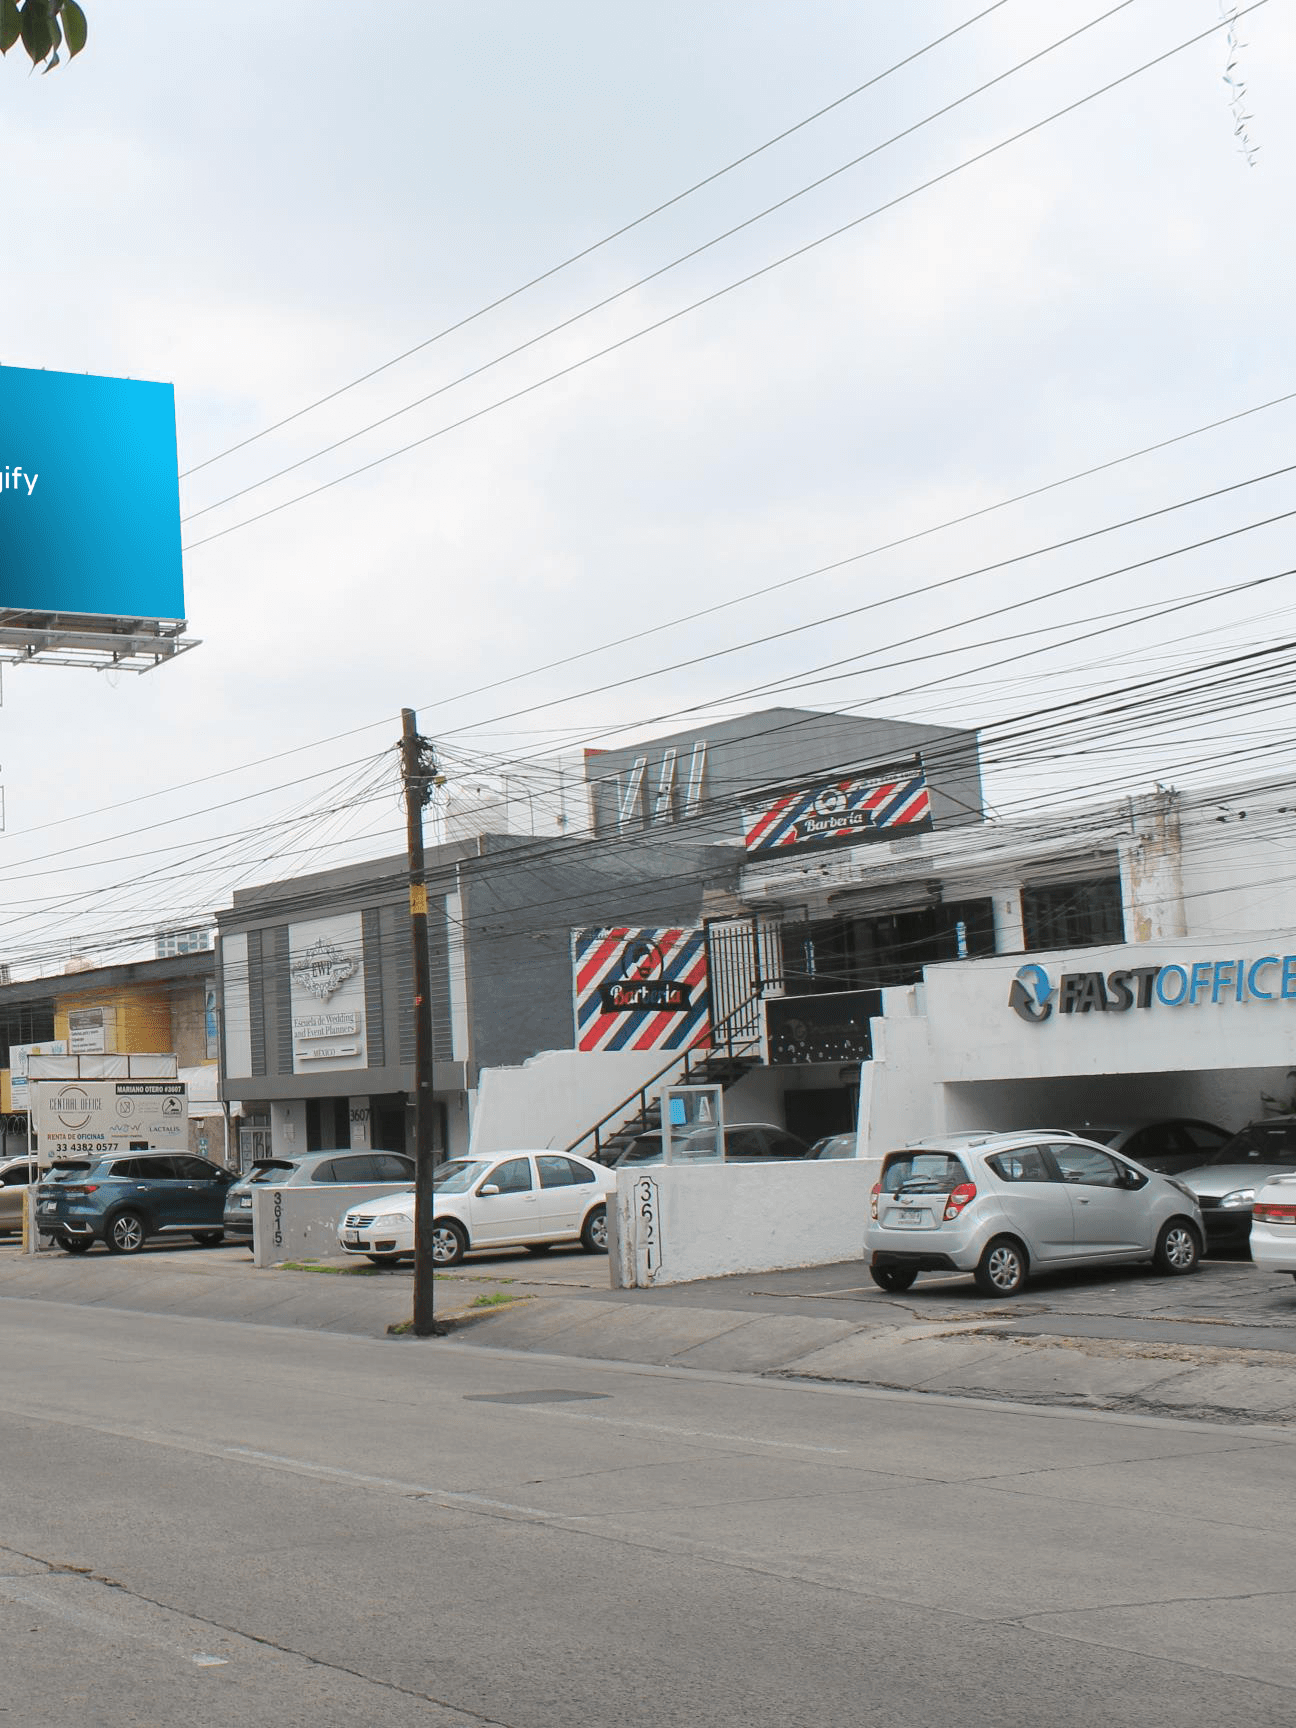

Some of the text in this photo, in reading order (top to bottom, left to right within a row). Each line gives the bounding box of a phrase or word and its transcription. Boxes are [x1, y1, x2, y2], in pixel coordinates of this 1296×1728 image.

[325, 1012, 354, 1025] Wedding
[294, 1024, 354, 1038] and Event Planners
[117, 1085, 144, 1093] MARIANO
[145, 1085, 164, 1093] OTERO
[49, 1098, 77, 1111] CENTRAL
[349, 1109, 371, 1122] 3607
[56, 1143, 119, 1152] 33 4382 0577
[273, 1191, 283, 1244] 3615
